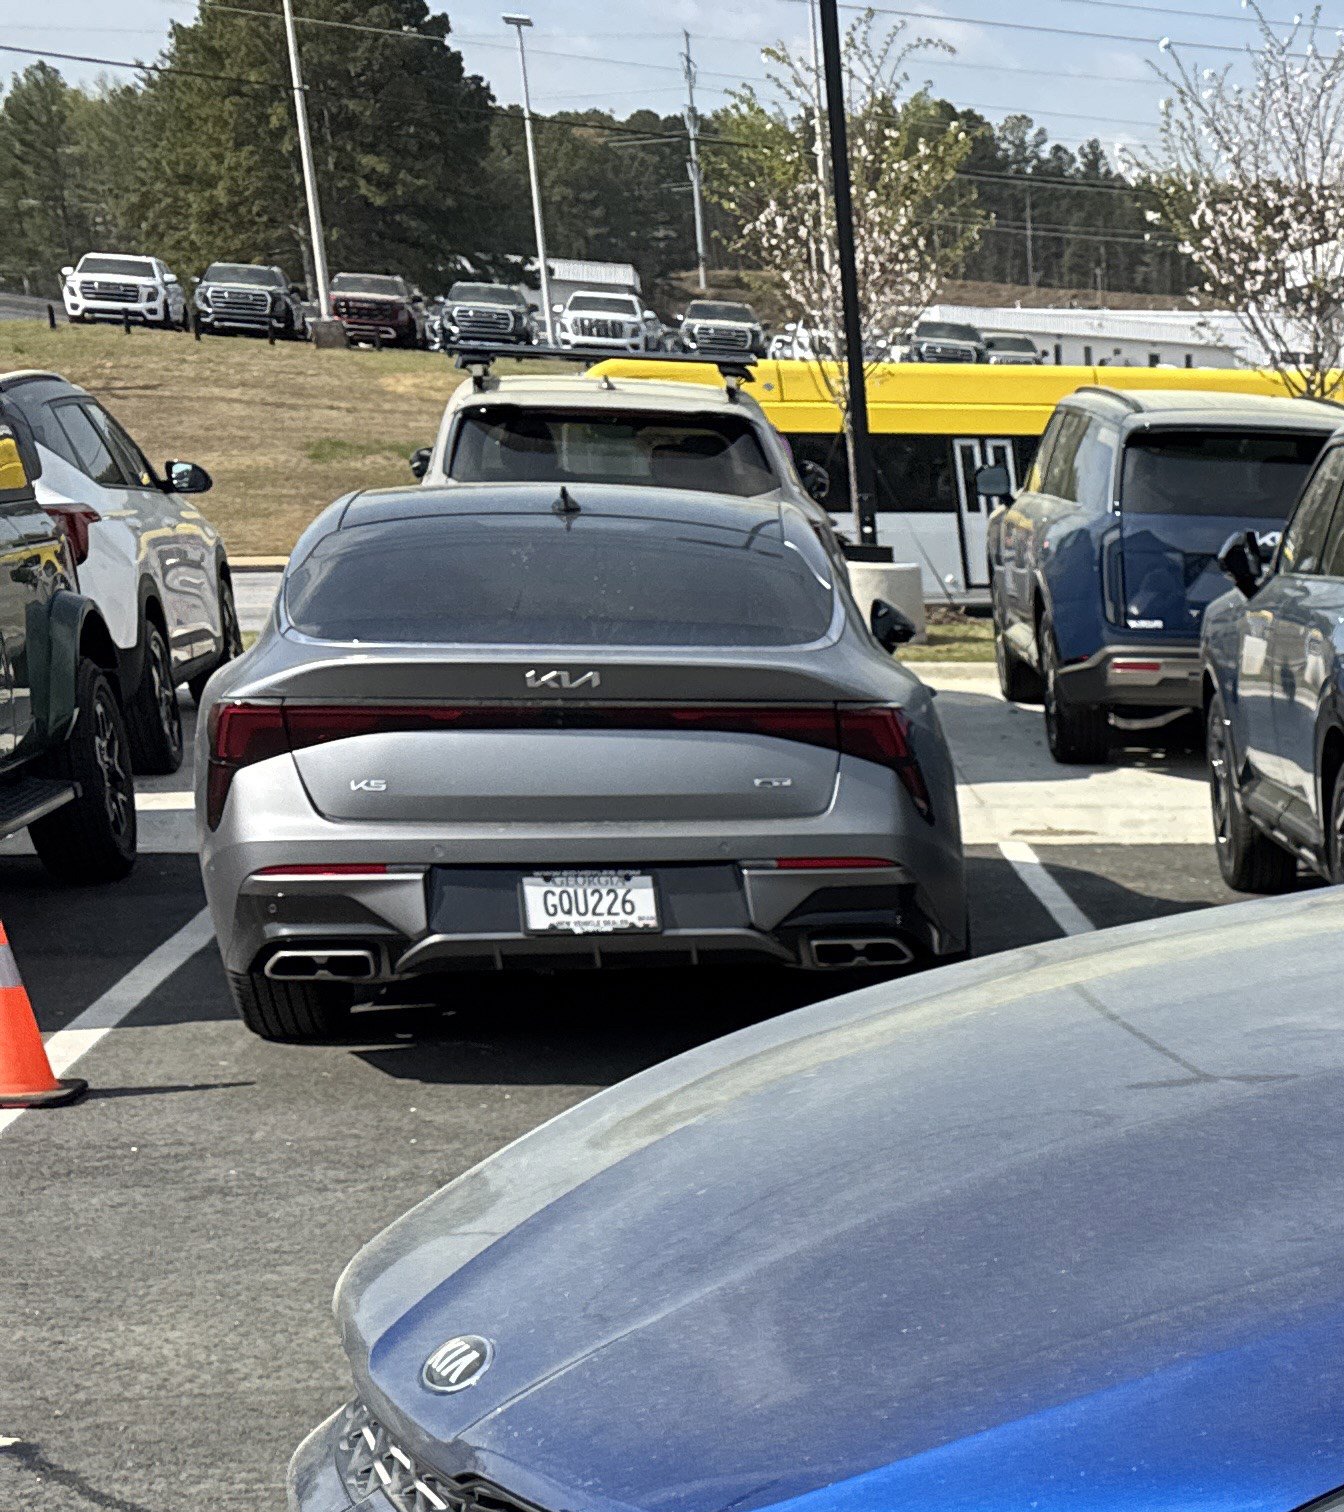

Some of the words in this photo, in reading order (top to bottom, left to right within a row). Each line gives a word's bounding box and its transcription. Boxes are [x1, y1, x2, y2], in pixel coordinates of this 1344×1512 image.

[525, 669, 601, 689] KIA
[349, 779, 387, 792] K5
[552, 876, 626, 887] GEORGIA
[543, 889, 635, 917] GQU226
[427, 1338, 480, 1384] KIA
